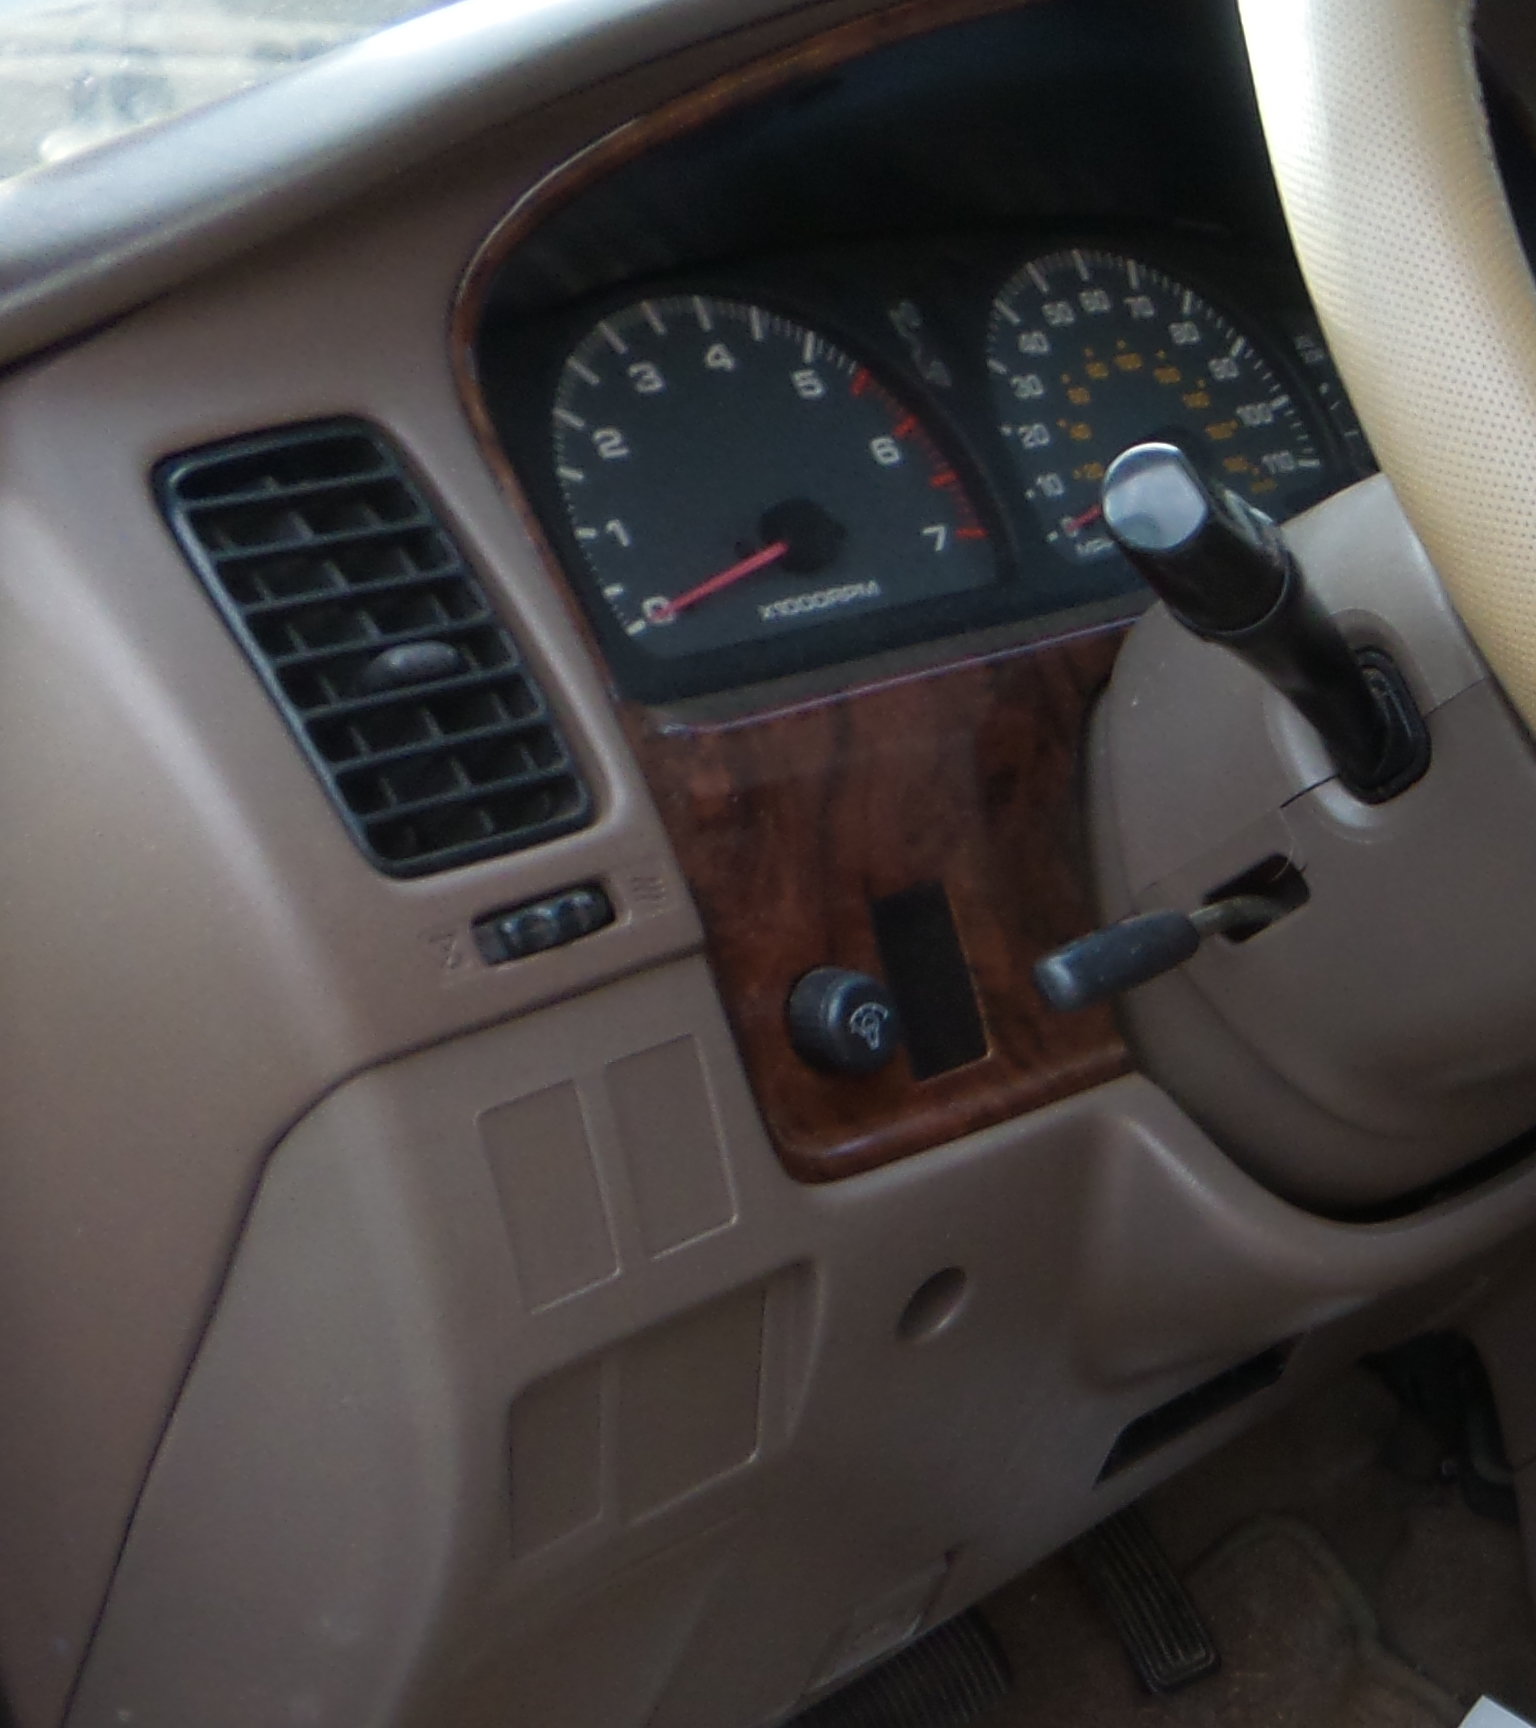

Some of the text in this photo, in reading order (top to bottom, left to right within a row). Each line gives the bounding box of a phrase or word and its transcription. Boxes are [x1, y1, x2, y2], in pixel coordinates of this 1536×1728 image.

[705, 344, 735, 371] 4
[628, 362, 665, 393] 3
[792, 369, 825, 398] 5
[593, 427, 629, 459] 2
[869, 436, 901, 466] 6
[606, 519, 630, 547] 1
[922, 524, 947, 551] 7
